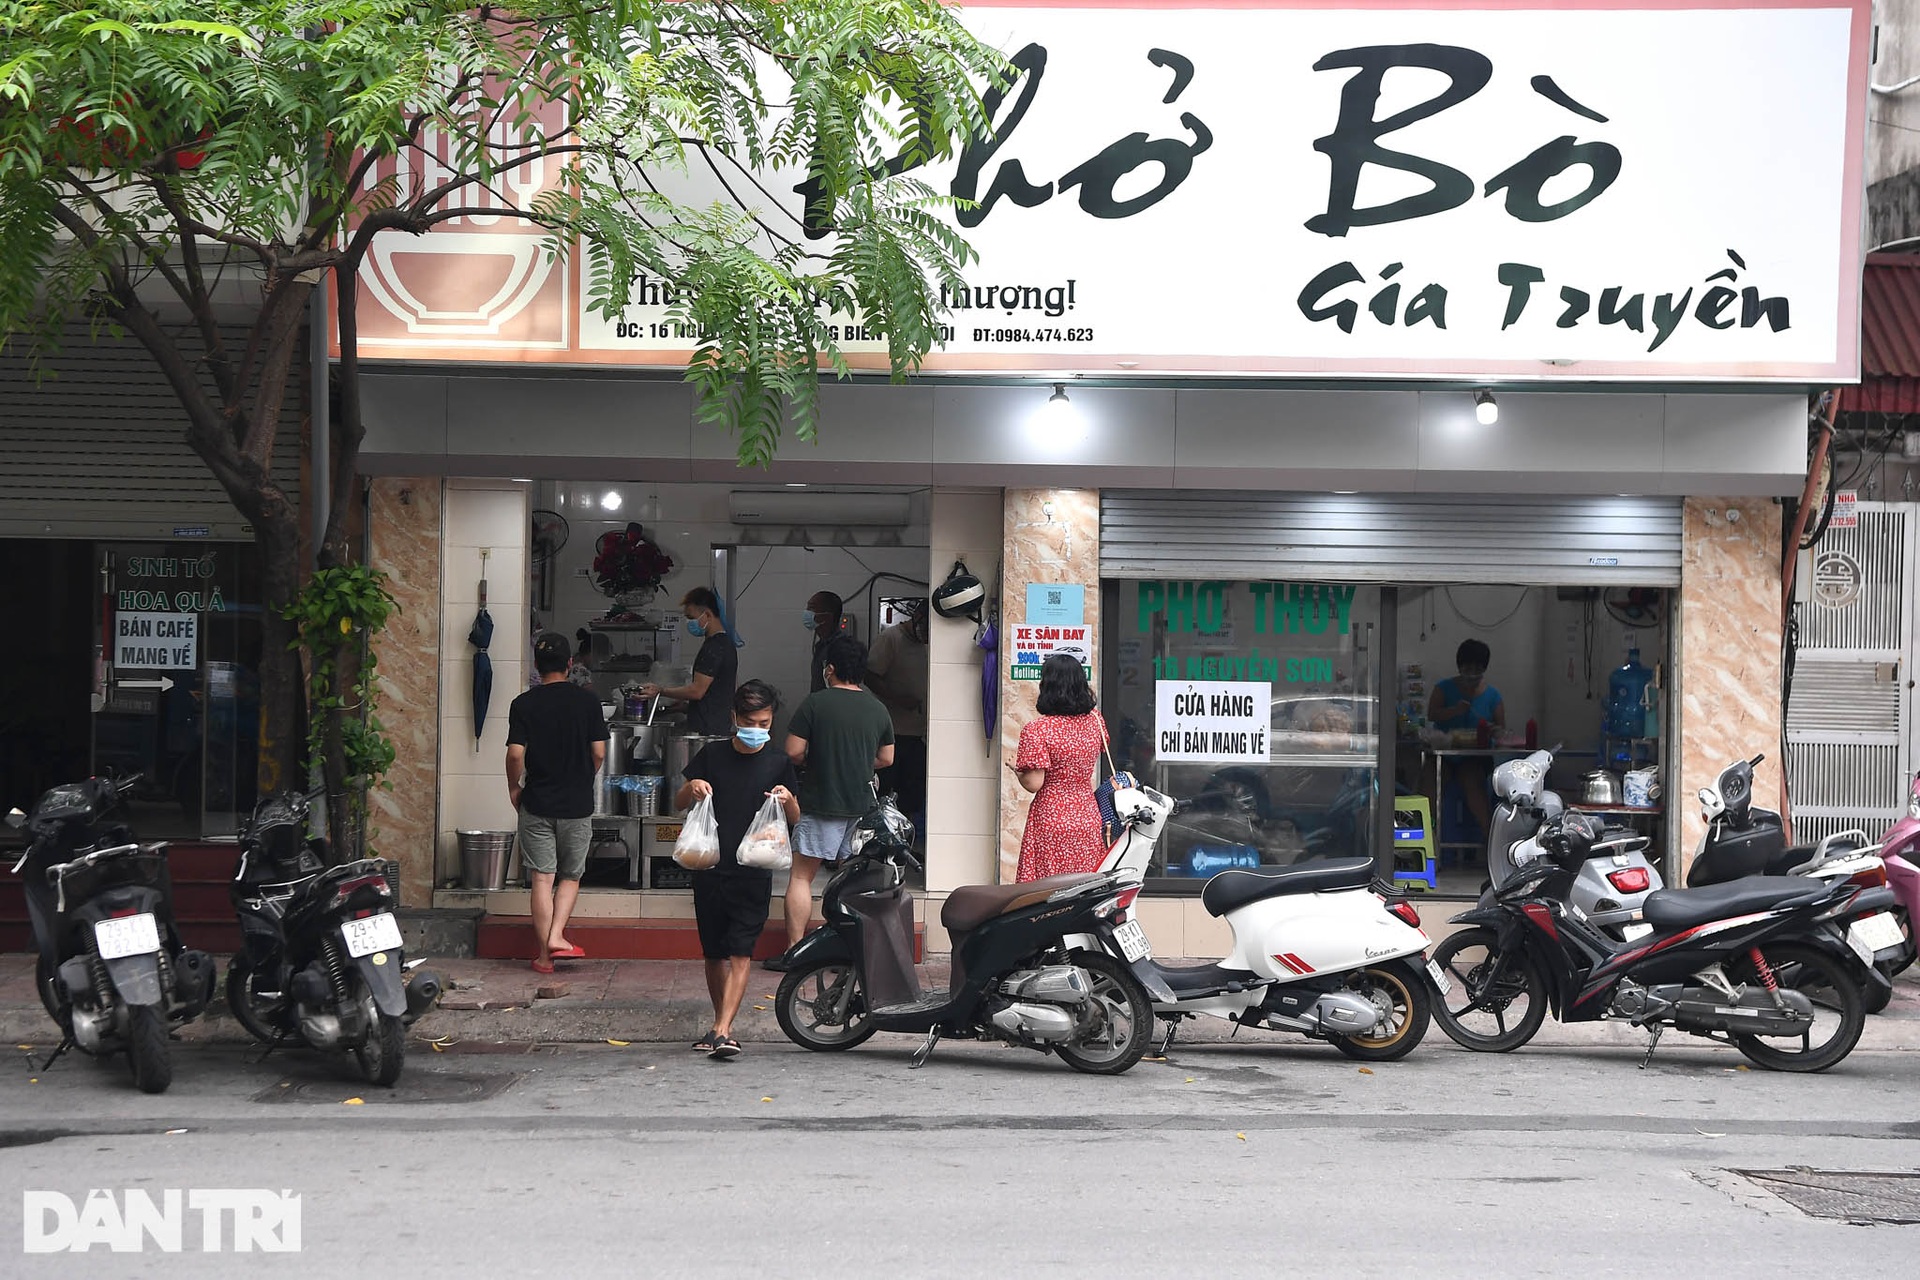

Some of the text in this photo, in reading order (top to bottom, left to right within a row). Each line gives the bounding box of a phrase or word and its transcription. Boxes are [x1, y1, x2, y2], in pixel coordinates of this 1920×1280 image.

[1304, 43, 1622, 237] Bò
[1498, 248, 1791, 352] Truyền
[649, 322, 669, 338] 16
[128, 551, 217, 578] SINH TỐ
[119, 586, 226, 613] HOA QUẢ
[119, 616, 194, 639] BÁN CAFÉ
[1017, 626, 1085, 640] XE SÂN BAY
[121, 647, 168, 665] MANG
[1175, 684, 1253, 717] CỬA HÀNG
[1161, 723, 1181, 753] CHỈ
[1184, 727, 1208, 754] BÁN
[1212, 732, 1247, 754] MANG
[1029, 904, 1075, 923] VISION
